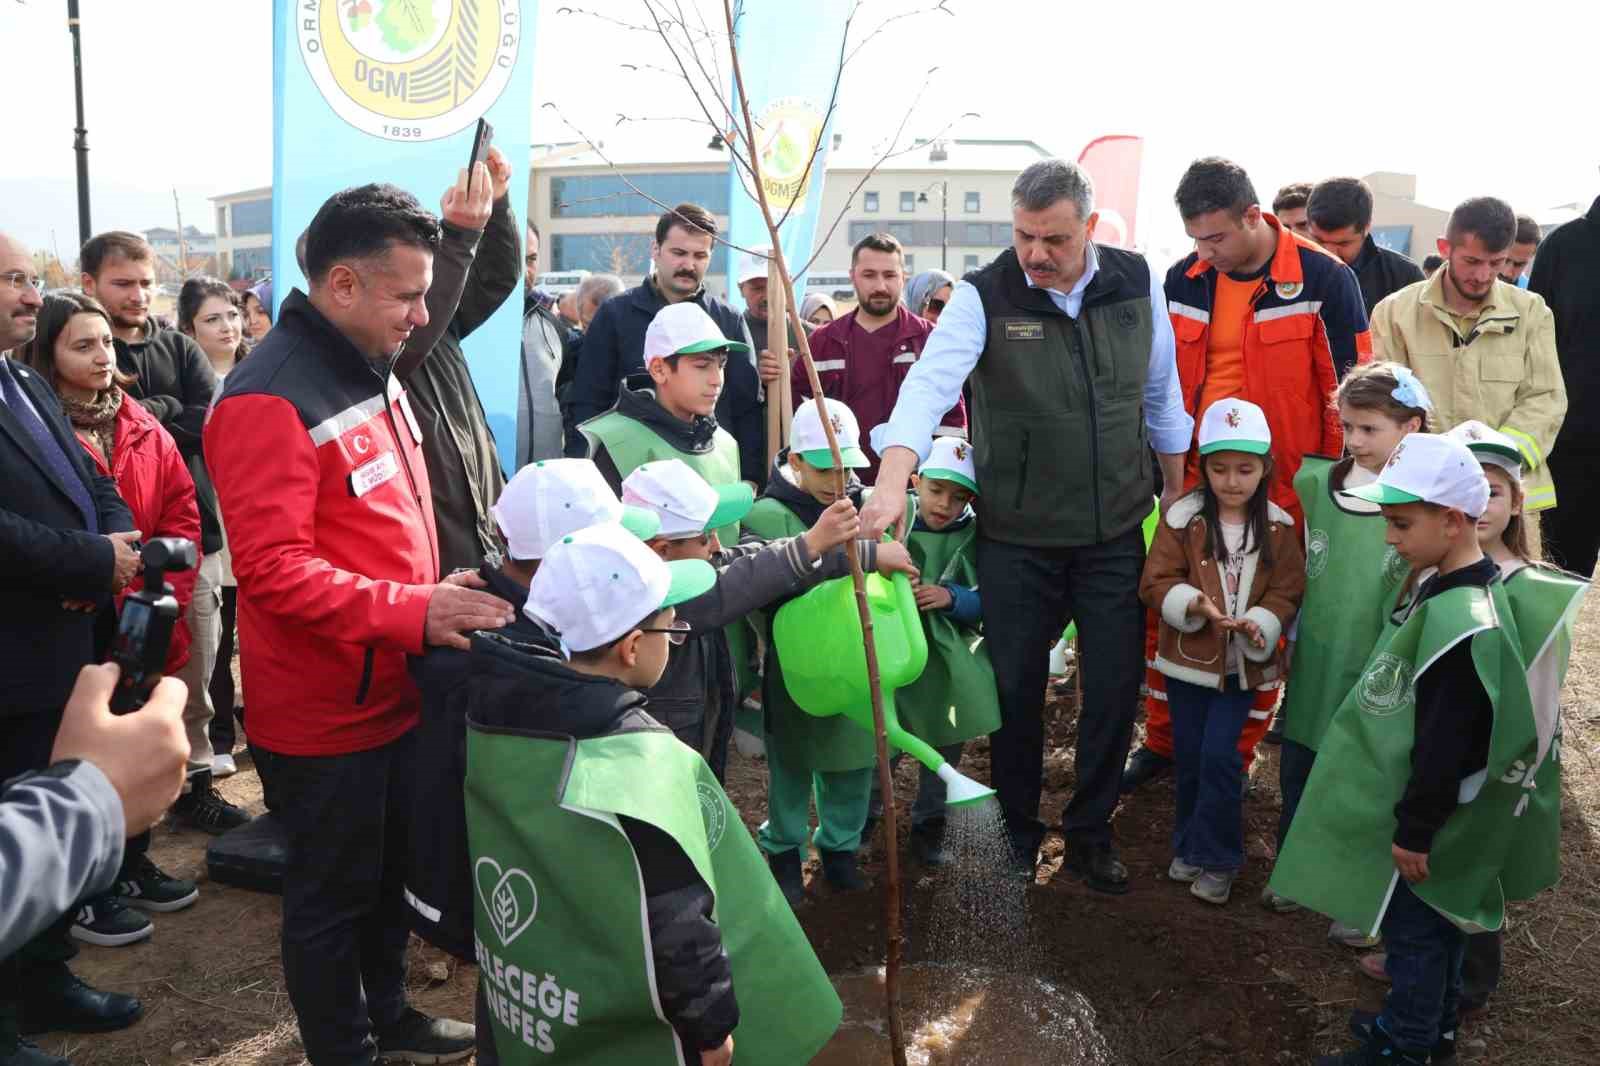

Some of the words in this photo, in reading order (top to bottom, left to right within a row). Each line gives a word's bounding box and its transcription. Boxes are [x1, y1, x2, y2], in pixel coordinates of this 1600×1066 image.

[354, 58, 408, 103] OGM
[382, 125, 422, 138] 1839
[764, 178, 790, 200] OGM
[485, 978, 556, 1054] NEFES
